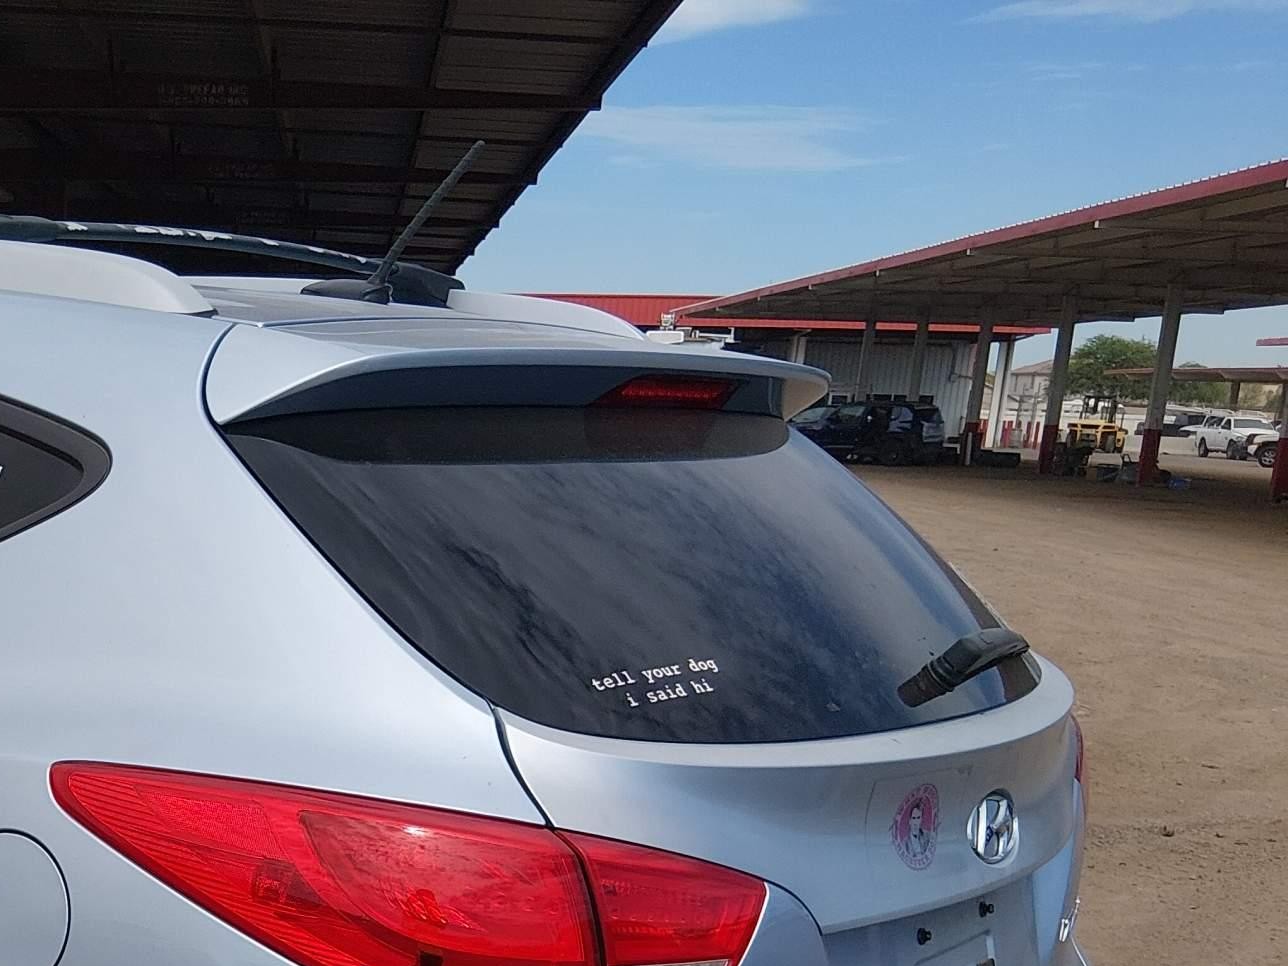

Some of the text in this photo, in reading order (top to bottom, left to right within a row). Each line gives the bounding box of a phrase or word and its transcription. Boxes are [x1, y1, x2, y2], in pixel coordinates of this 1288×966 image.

[591, 658, 719, 691] tell your dog
[626, 678, 714, 707] i said hi
